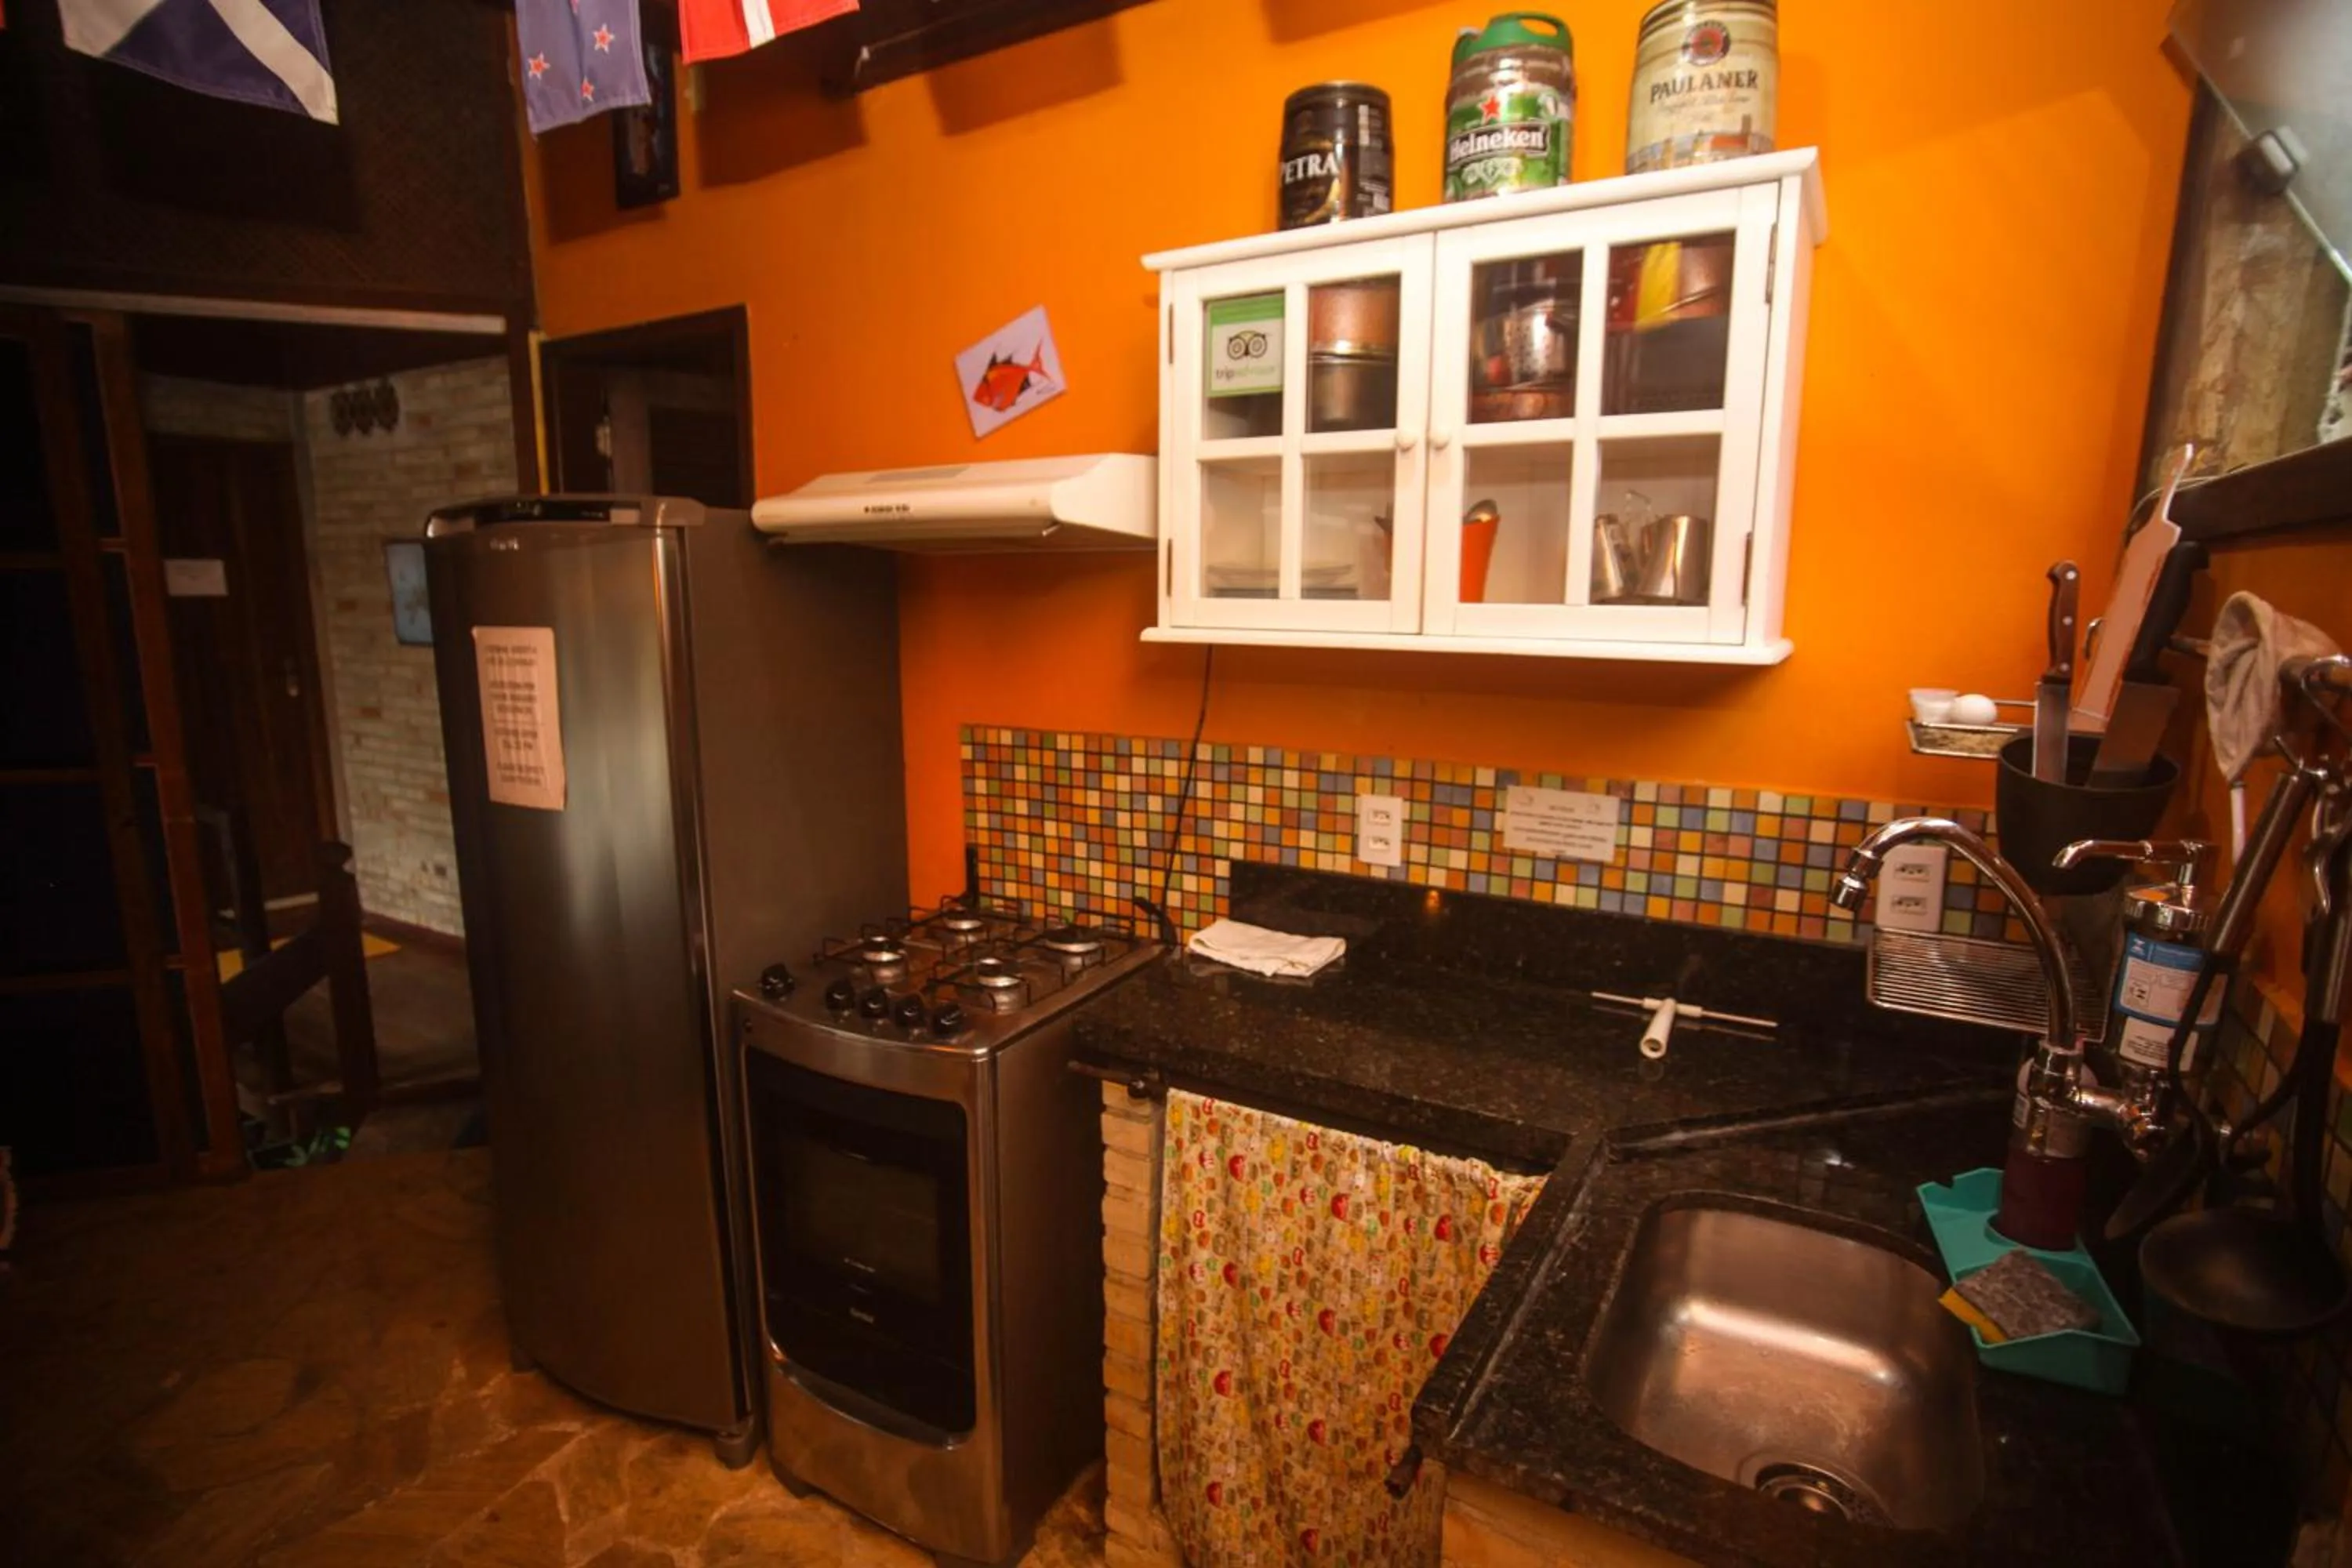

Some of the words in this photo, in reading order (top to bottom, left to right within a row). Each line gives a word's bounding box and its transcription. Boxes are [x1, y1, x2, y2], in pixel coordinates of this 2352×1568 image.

[1650, 68, 1759, 104] PAULANER
[1450, 125, 1545, 164] Heineken
[1216, 364, 1277, 381] tripad
